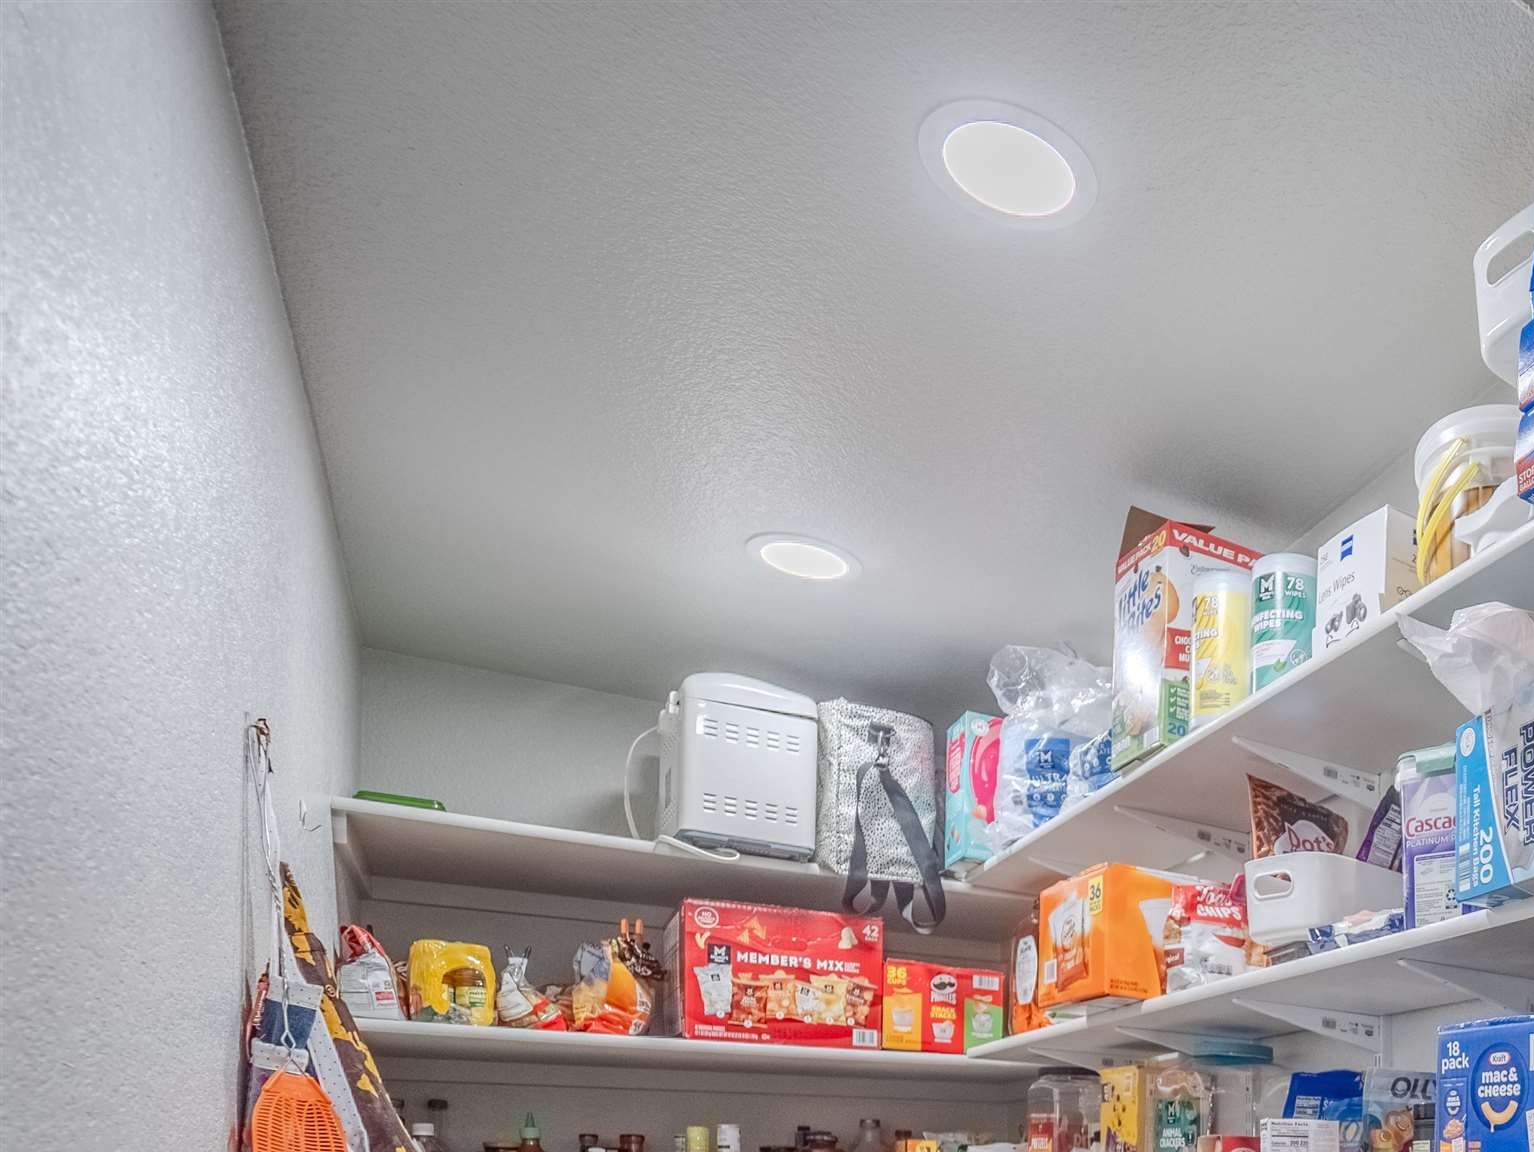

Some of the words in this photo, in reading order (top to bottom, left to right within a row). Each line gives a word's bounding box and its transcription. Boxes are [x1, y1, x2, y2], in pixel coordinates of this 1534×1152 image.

[1151, 530, 1167, 553] 20
[1172, 529, 1235, 559] VALUE
[1287, 576, 1305, 591] 78
[1333, 571, 1356, 593] Wipes
[1285, 590, 1306, 598] WIPES
[1254, 607, 1304, 623] NFECTING
[1254, 620, 1281, 633] WIPES
[1168, 723, 1186, 737] 20
[1502, 745, 1520, 836] FLEX
[1406, 816, 1456, 838] Casca
[1472, 808, 1481, 855] Kitchen
[1285, 823, 1334, 851] Dot's
[1406, 837, 1449, 849] PLATINUM
[1479, 826, 1494, 884] 200
[1088, 885, 1101, 901] 36
[1196, 905, 1242, 921] CHIPS
[862, 924, 880, 938] 42
[736, 950, 812, 969] MEMBER'S
[816, 959, 844, 972] MIX
[886, 966, 907, 979] 36
[930, 1012, 957, 1020] STACKS
[931, 1005, 956, 1013] SNACK
[1446, 1040, 1460, 1057] 18
[1441, 1053, 1470, 1074] pack
[1492, 1055, 1507, 1063] Kraft
[1163, 1128, 1182, 1137] ANIMAL
[1160, 1136, 1185, 1149] CRACKERS
